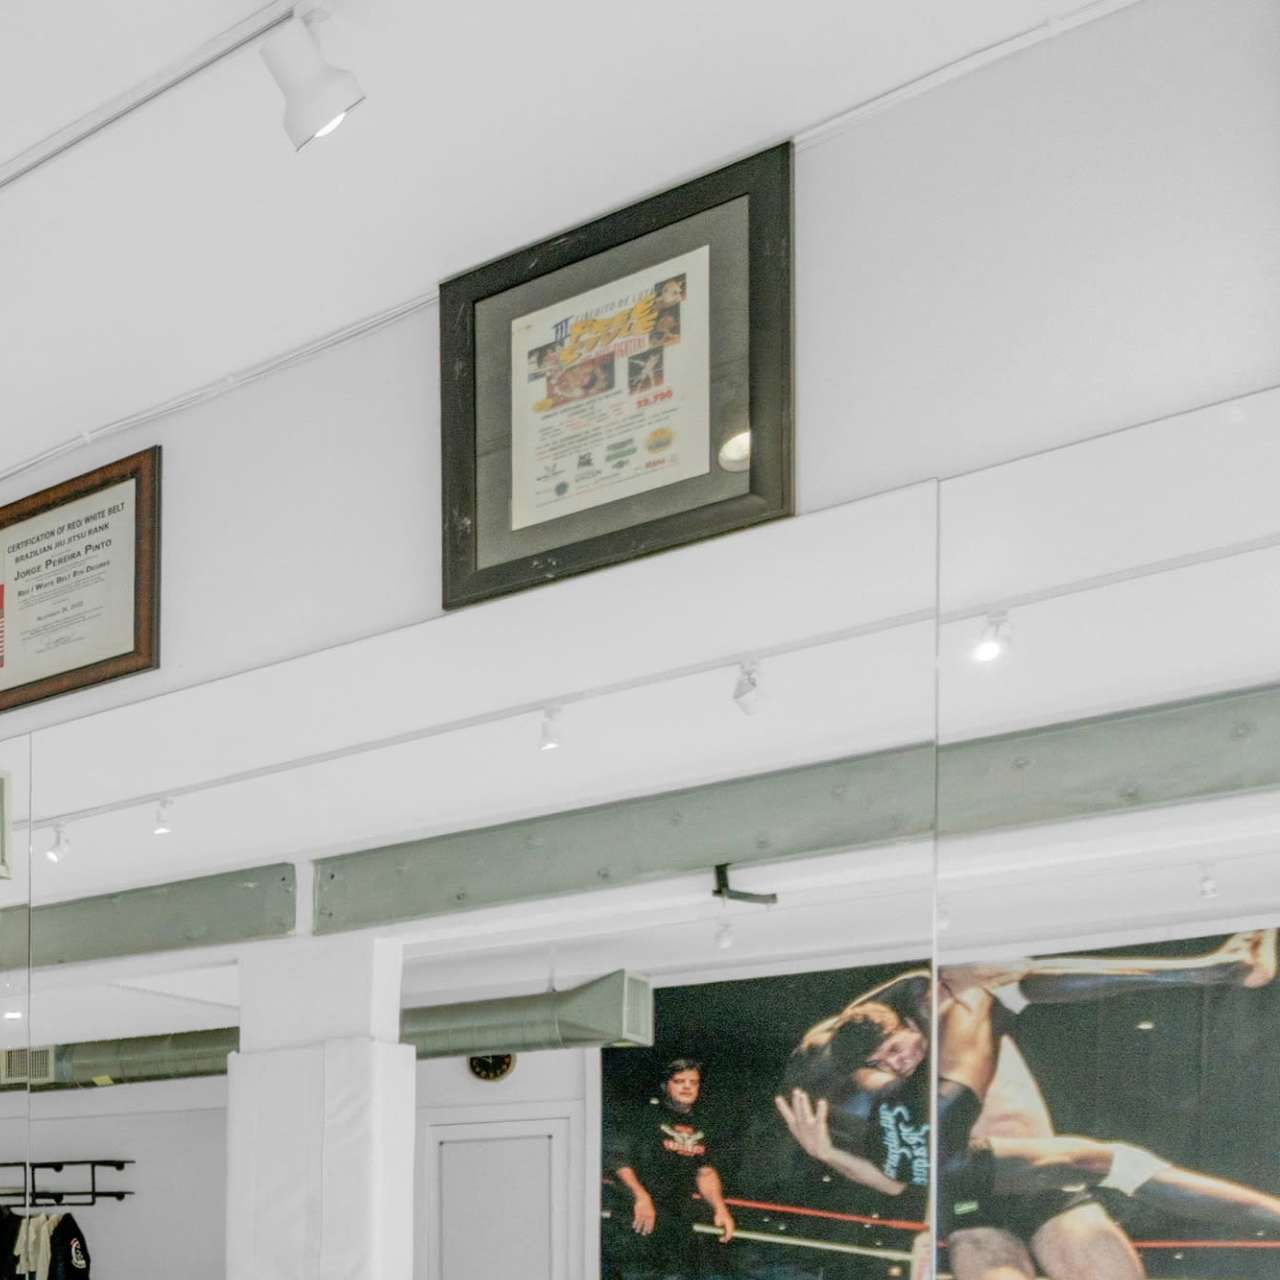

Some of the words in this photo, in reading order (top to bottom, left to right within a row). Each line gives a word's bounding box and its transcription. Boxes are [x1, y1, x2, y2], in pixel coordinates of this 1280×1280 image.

[7, 529, 55, 554] CERTIFICATION
[57, 525, 65, 535] OF
[84, 510, 106, 525] WHITE
[108, 502, 125, 516] BELT
[15, 544, 52, 564] BRAZILIAN
[67, 531, 86, 544] JITSU
[88, 522, 109, 537] RANK
